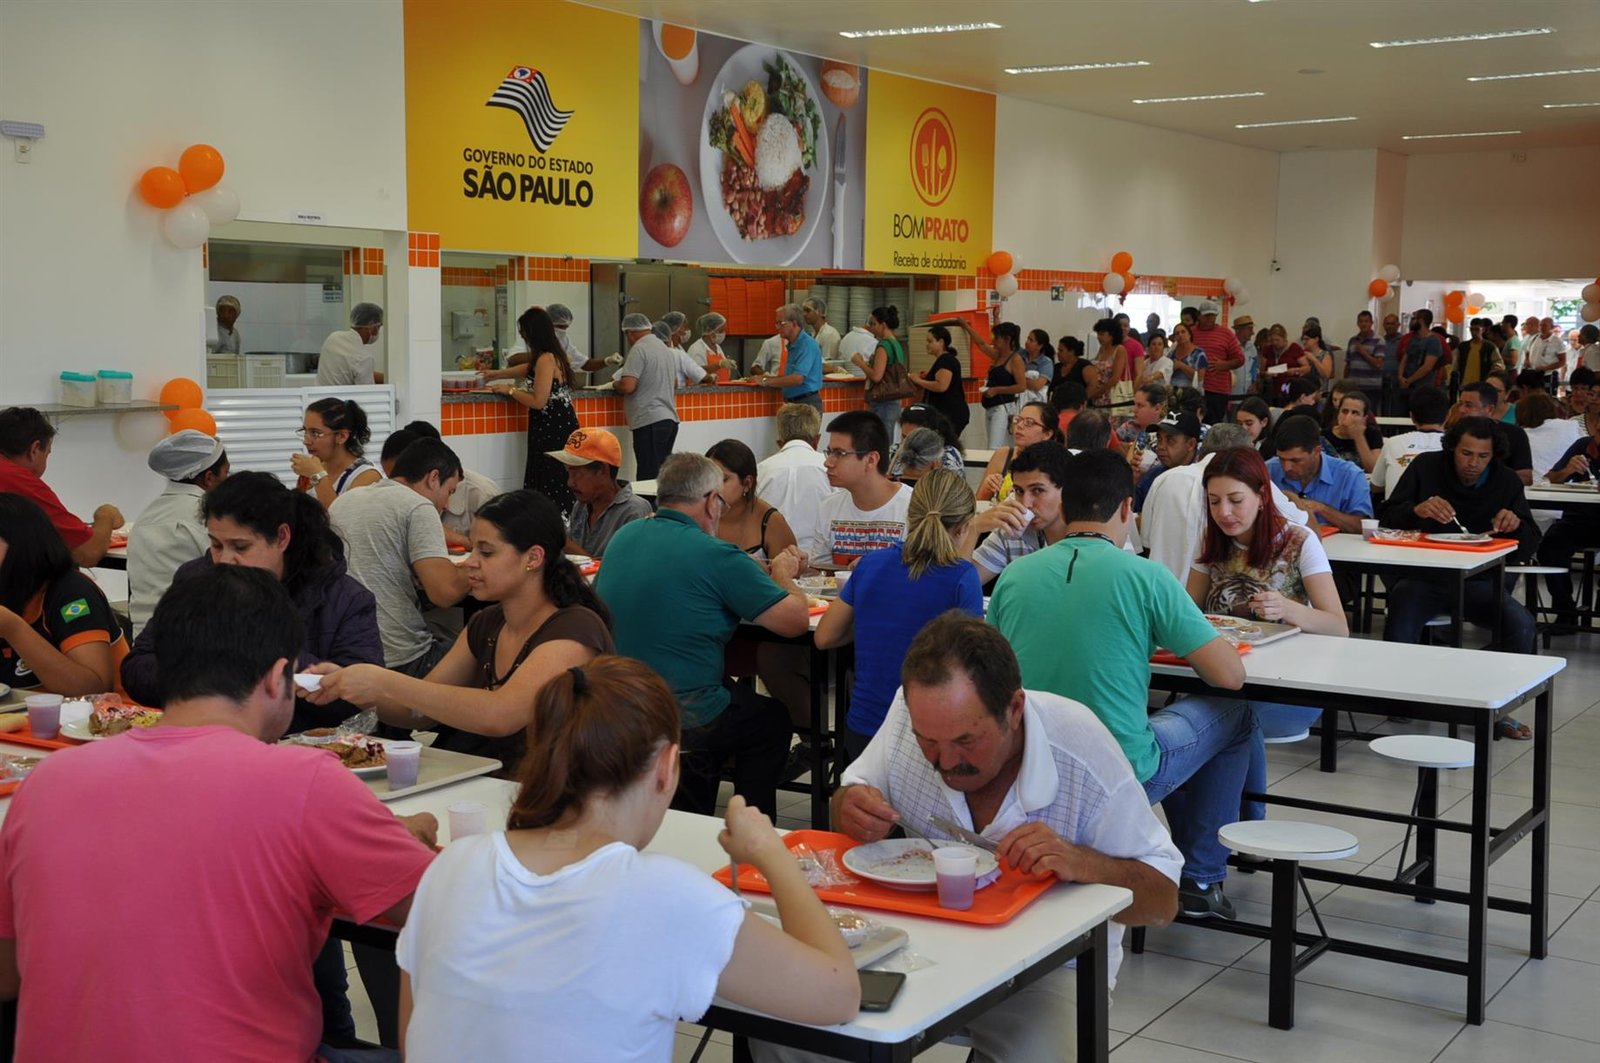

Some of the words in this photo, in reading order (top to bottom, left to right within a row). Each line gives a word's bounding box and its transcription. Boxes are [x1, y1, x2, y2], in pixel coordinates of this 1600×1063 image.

[463, 147, 525, 168] GOVERNO
[528, 155, 546, 170] DO
[549, 157, 594, 175] ESTADO
[463, 164, 517, 201] SÃO
[519, 174, 594, 208] PAULO
[893, 250, 920, 268] Receita
[920, 250, 931, 268] de
[931, 251, 967, 270] cidadania
